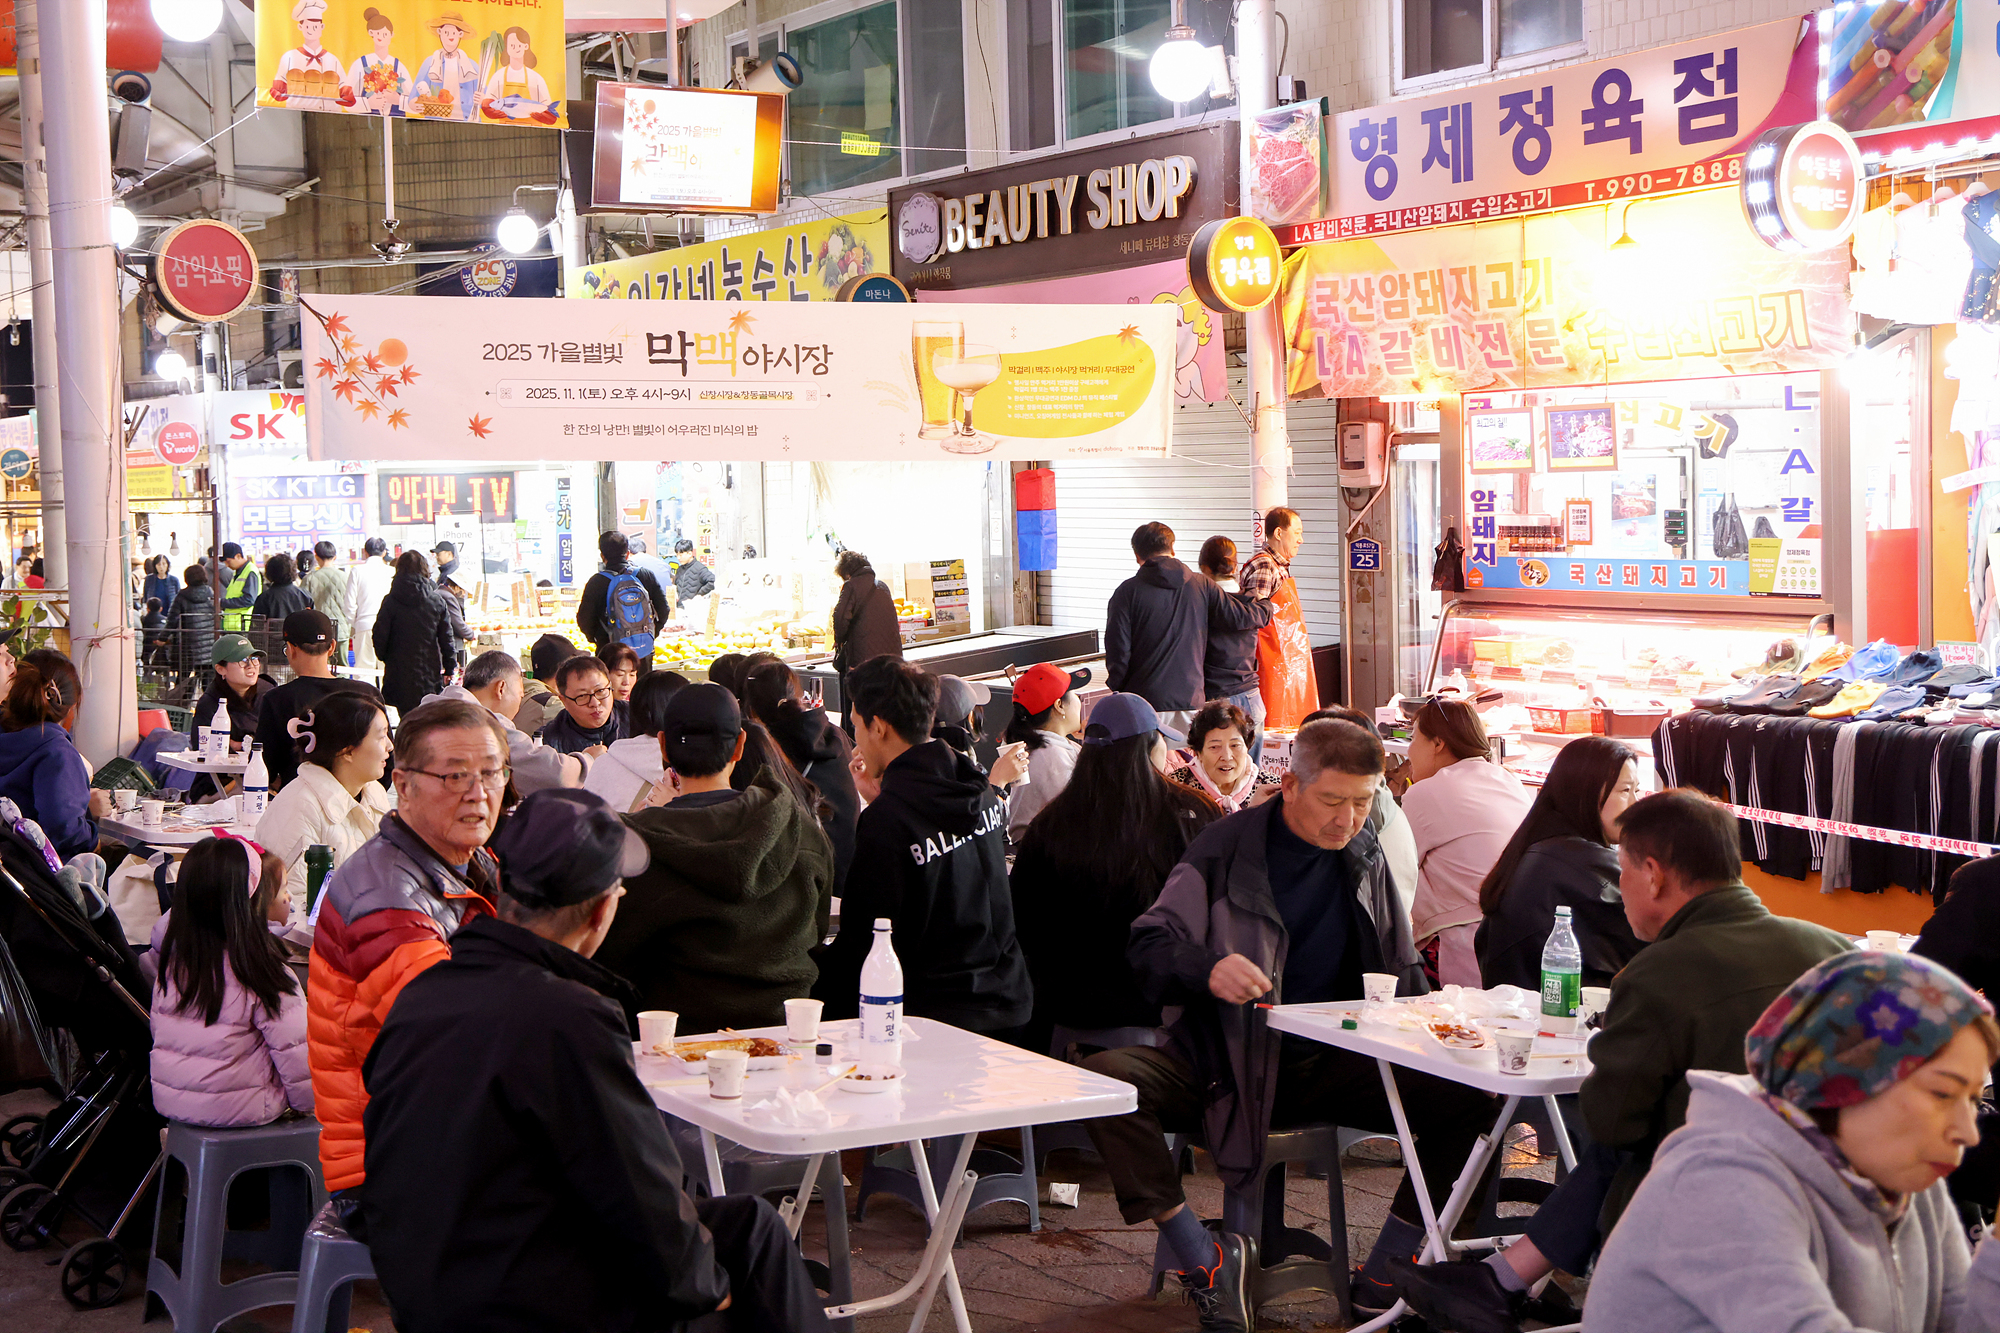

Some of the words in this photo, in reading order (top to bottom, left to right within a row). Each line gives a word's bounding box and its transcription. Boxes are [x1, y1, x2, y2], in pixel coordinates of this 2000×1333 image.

[1349, 47, 1739, 199] 형제정육점
[946, 174, 1080, 252] BEAUTY
[1087, 155, 1197, 230] SHOP
[1145, 235, 1170, 251] 뷰티샵
[172, 254, 242, 288] 삼익쇼핑
[477, 276, 502, 286] ZONE
[865, 289, 891, 300] 마돈나
[1315, 256, 1555, 324] 국산암돼지고기
[482, 342, 533, 362] 2025
[537, 341, 624, 364] 가을별빛
[1008, 366, 1031, 375] 막걸리
[1035, 366, 1051, 375] 맥주
[1055, 366, 1078, 375] 야시장
[1079, 366, 1101, 374] 먹거리
[525, 387, 561, 401] 2025.
[563, 387, 576, 401] 11.
[577, 386, 607, 401] 1(토)
[609, 387, 639, 401] 오후
[642, 387, 692, 402] 4시~9시
[229, 413, 286, 440] SK
[563, 423, 575, 437] 한
[577, 423, 601, 437] 잔의
[603, 423, 631, 437] 낭만!
[632, 423, 666, 437] 별빛이
[667, 423, 712, 437] 어우러진
[713, 424, 745, 437] 미식의
[746, 424, 759, 437] 밤
[174, 445, 196, 454] world
[245, 477, 280, 499] SK
[286, 477, 318, 498] KT
[324, 476, 356, 497] LG
[387, 475, 456, 523] 인터넷
[468, 476, 511, 517] TV
[242, 502, 365, 533] 모든통신사
[443, 530, 473, 540] iPhone
[1356, 554, 1375, 567] 25
[1569, 563, 1728, 590] 국산돼지고기
[255, 794, 263, 811] 지평
[885, 1009, 896, 1037] 지평
